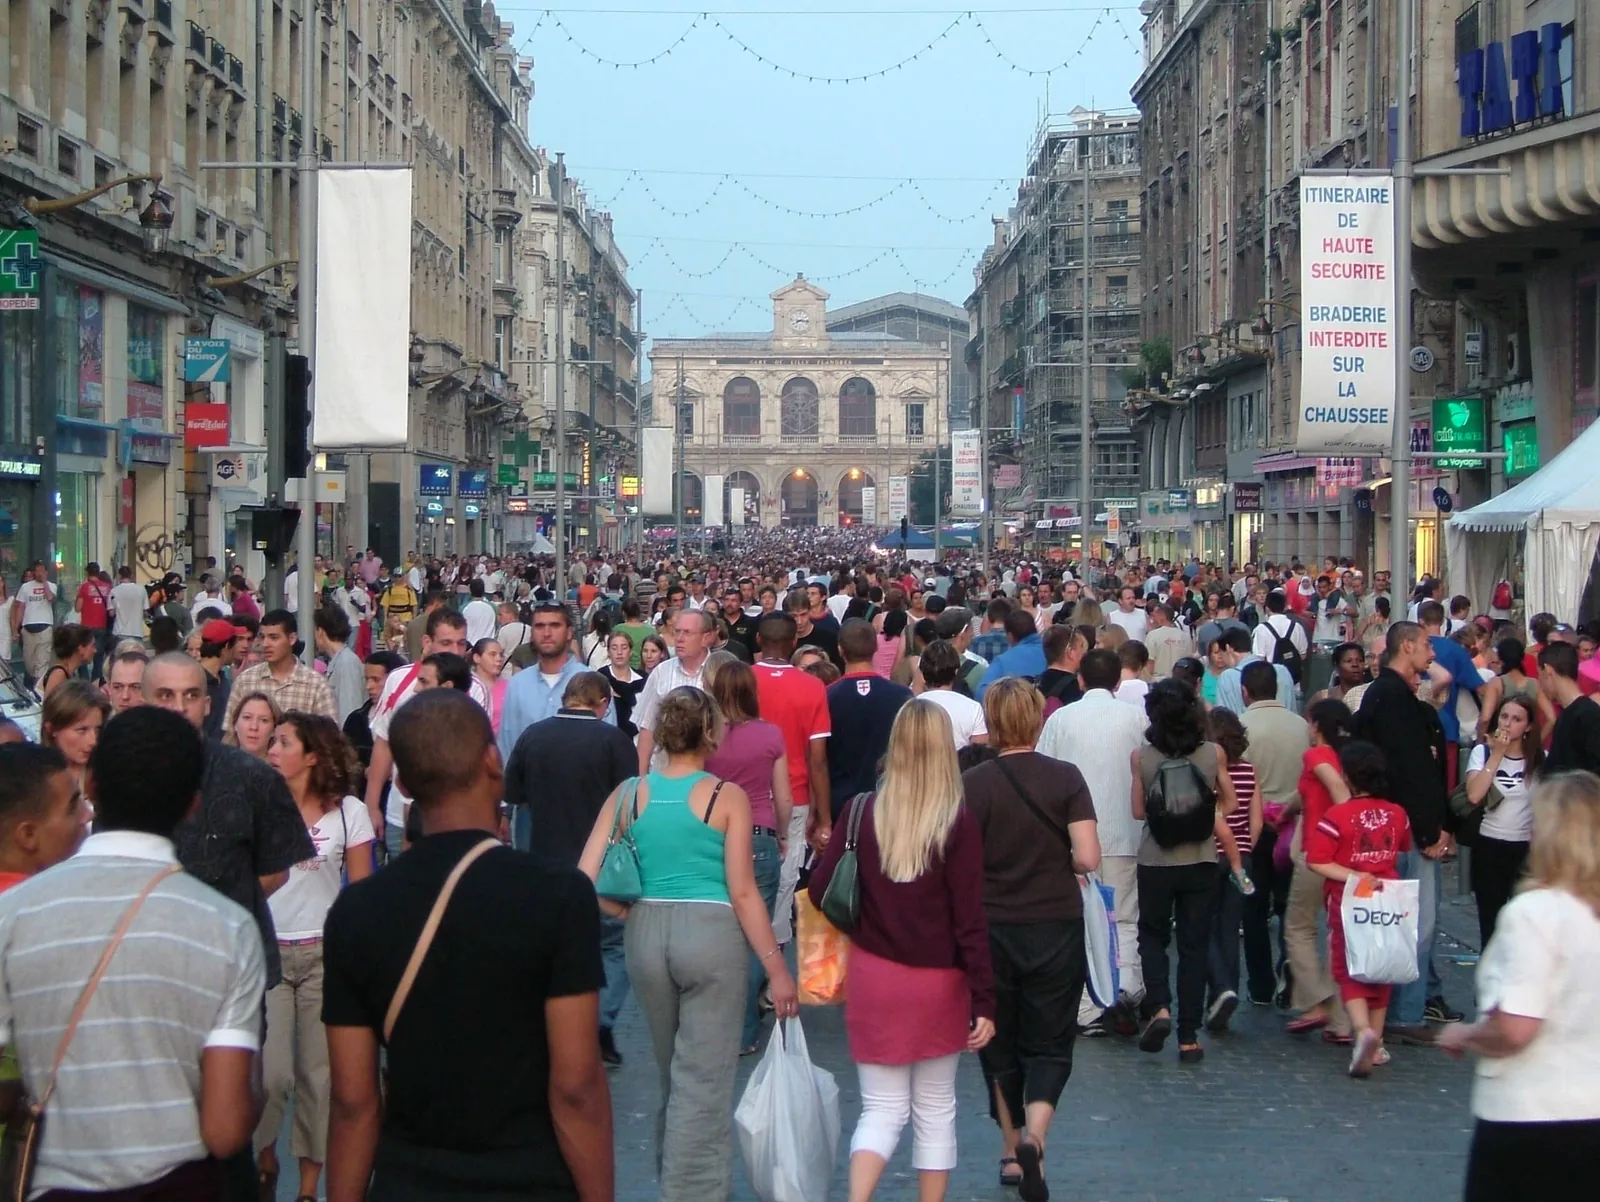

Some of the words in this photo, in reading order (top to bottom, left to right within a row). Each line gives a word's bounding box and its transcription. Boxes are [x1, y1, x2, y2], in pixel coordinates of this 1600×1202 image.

[1458, 22, 1562, 137] TATI
[1305, 187, 1389, 204] ITINERAIRE
[1338, 212, 1358, 228] DE
[1323, 238, 1373, 254] HAUTE
[1311, 263, 1385, 280] SECURITE
[1309, 306, 1387, 323] BRADERIE
[1309, 331, 1387, 348] INTERDITE
[1333, 356, 1364, 372] SUR
[1338, 381, 1356, 397] LA
[1304, 406, 1388, 424] CHAUSSEE
[1436, 495, 1449, 505] 16
